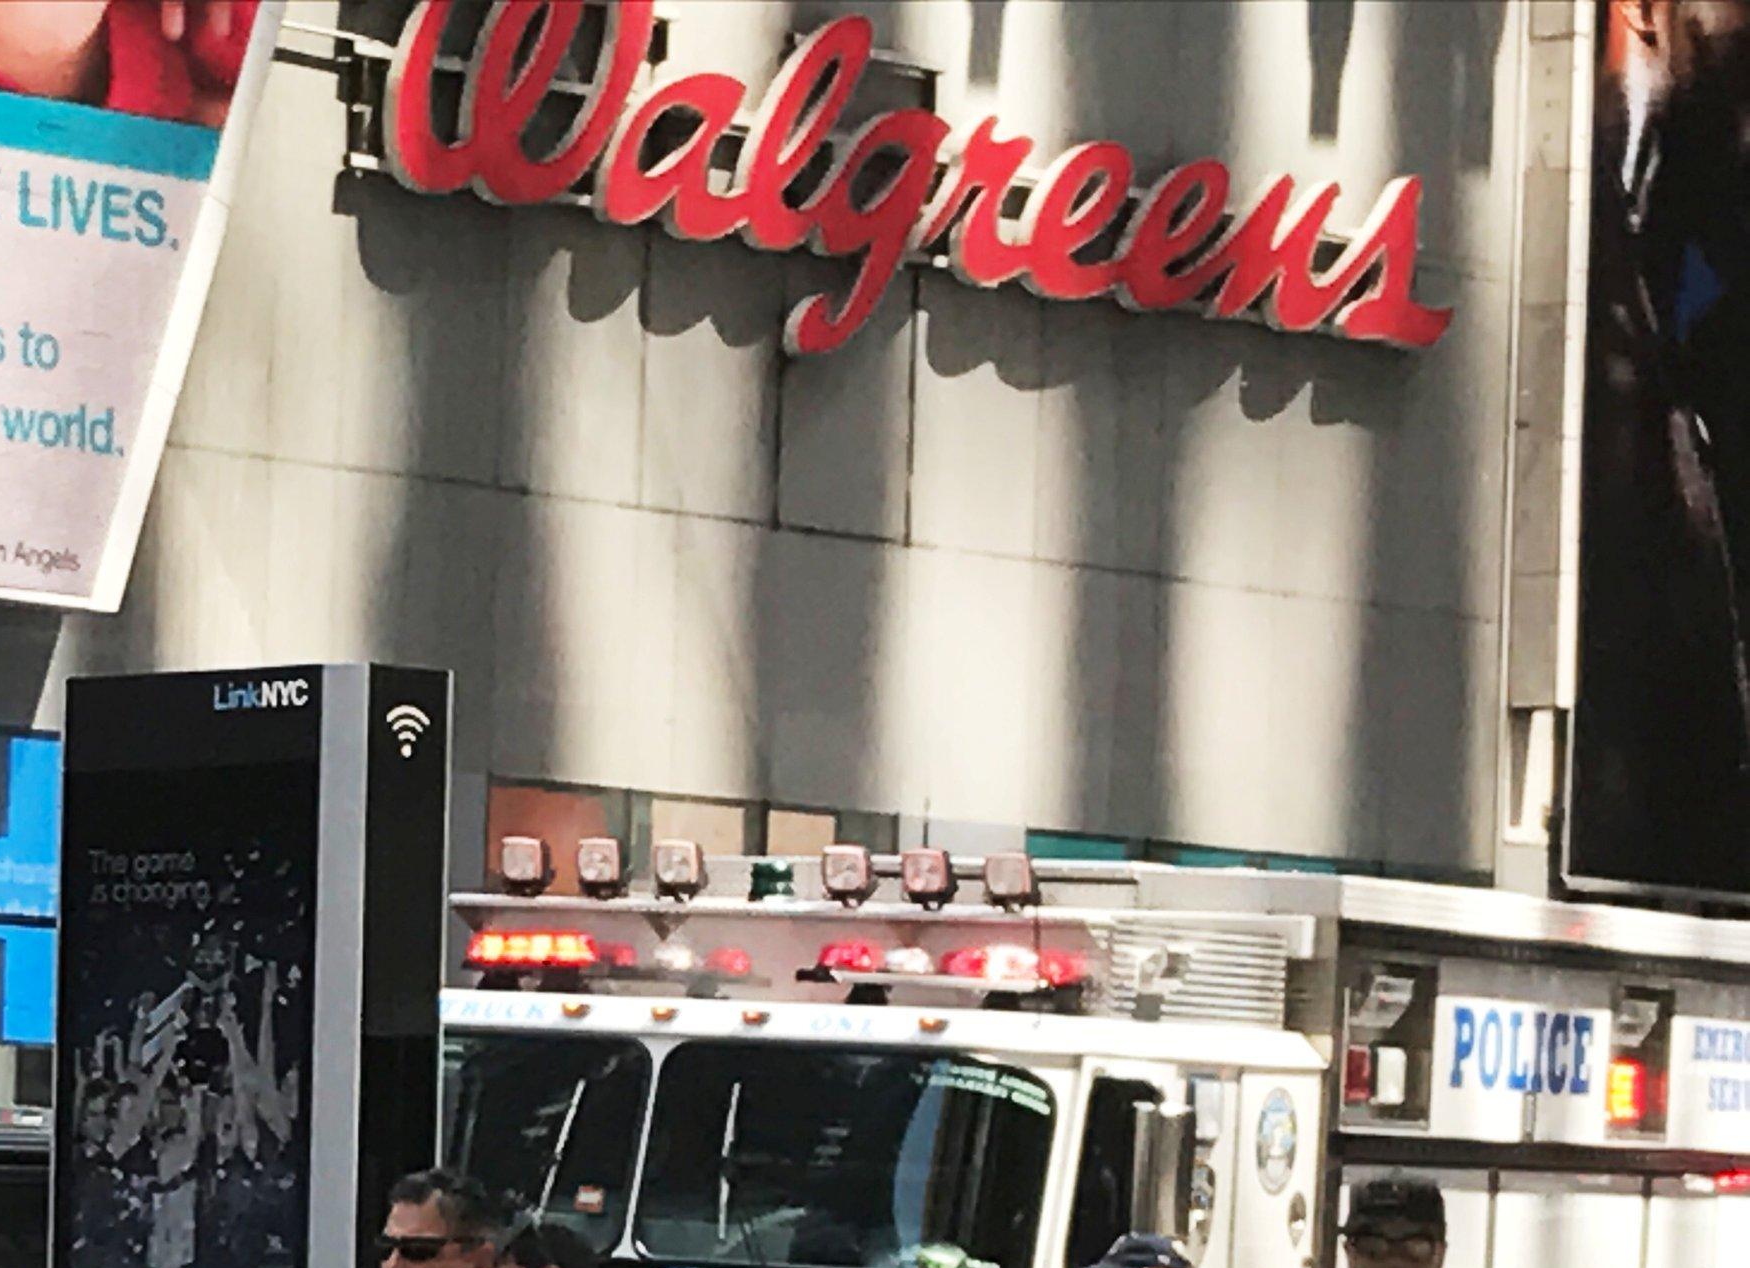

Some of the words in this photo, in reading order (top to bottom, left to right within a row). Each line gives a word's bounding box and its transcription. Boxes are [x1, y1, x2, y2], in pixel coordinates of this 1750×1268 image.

[387, 0, 1452, 353] Walgreens
[18, 170, 180, 251] LIVES.
[19, 321, 60, 371] to
[3, 402, 126, 458] world.
[13, 541, 81, 575] Angels
[213, 678, 309, 711] LinkNYC
[1450, 1005, 1594, 1096] POLICE
